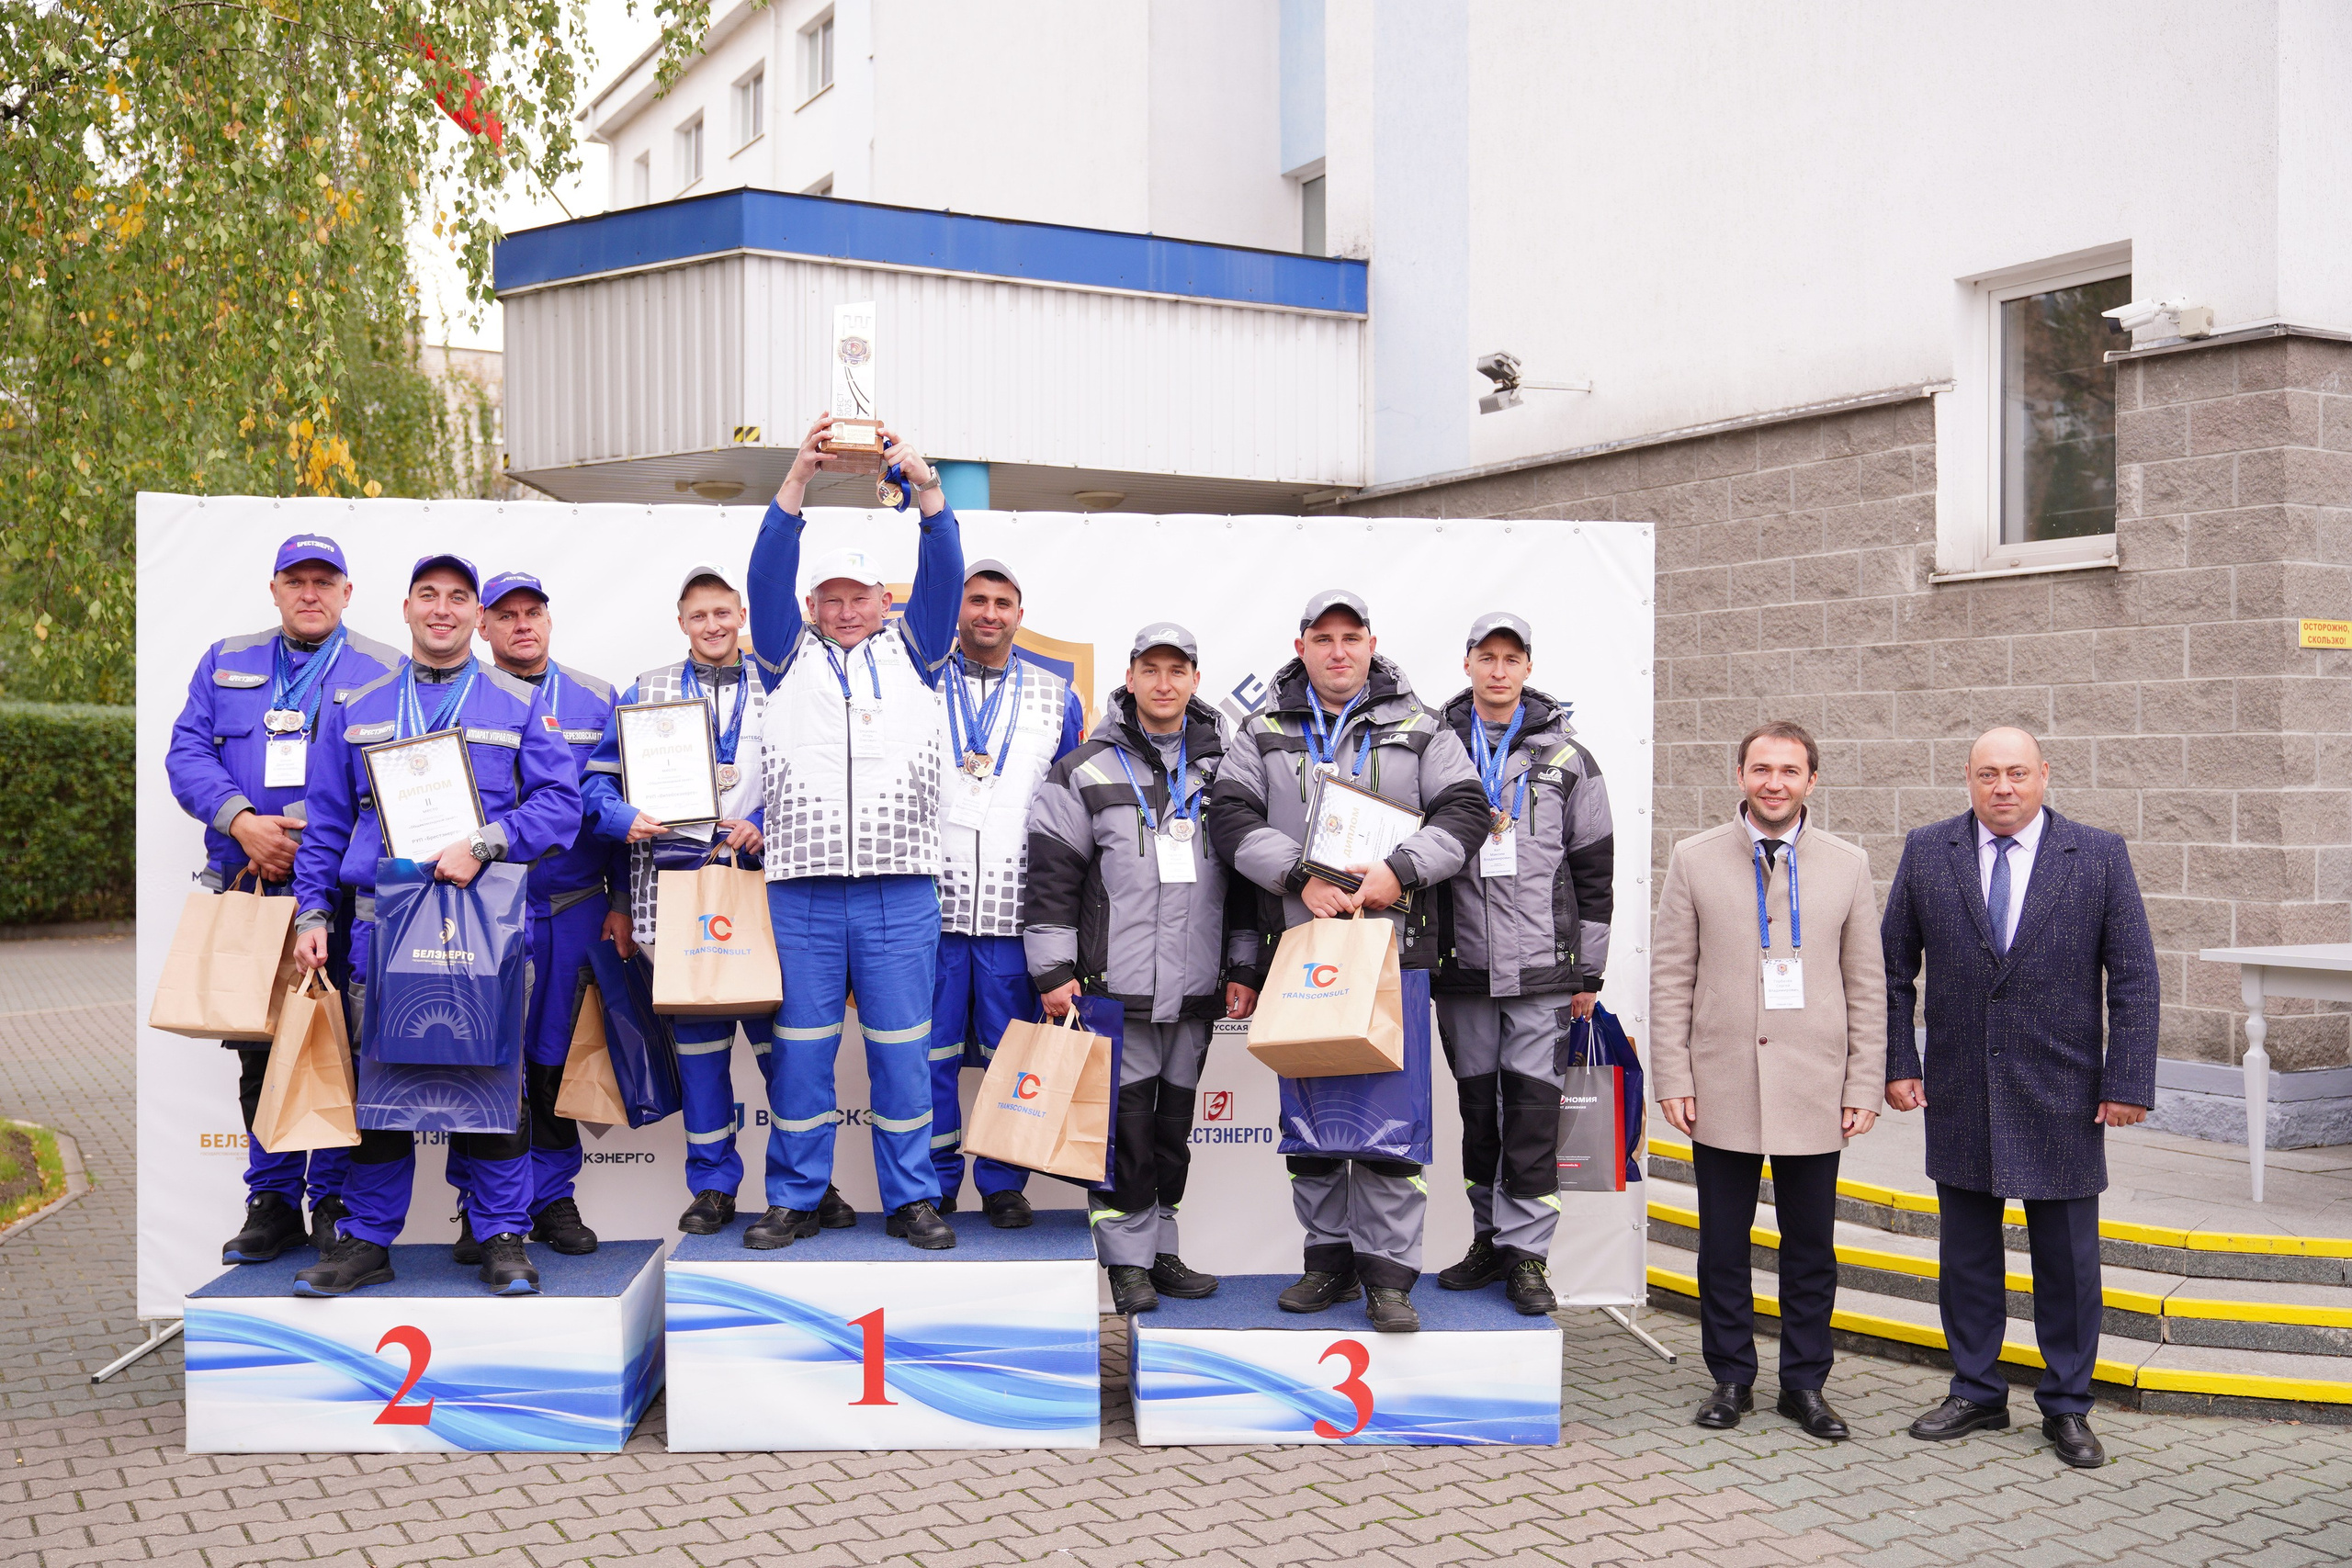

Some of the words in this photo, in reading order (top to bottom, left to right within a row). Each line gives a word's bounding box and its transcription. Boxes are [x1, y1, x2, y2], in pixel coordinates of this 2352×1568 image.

[836, 392, 844, 416] БРЕСТ
[834, 423, 845, 440] 1
[2303, 623, 2349, 634] ОСТОРОЖНО,
[2308, 636, 2346, 645] СКОЛЬЗКО!
[467, 728, 490, 739] АППАРАТ
[490, 729, 521, 745] УПРАВЛЕНИЯ
[562, 731, 597, 740] БЕРЕЗОВСКАЯ
[641, 744, 693, 759] ДИПЛОМ
[398, 779, 452, 801] ДИПЛОМ
[1343, 807, 1361, 859] ДИПЛОМ
[413, 949, 475, 962] БЕЛЭНЕРГО
[684, 946, 752, 957] TRANSCONSULT
[1282, 987, 1351, 999] TRANSCONSULT
[997, 1102, 1046, 1118] TRANSCONSULT
[582, 1153, 655, 1164] КЭНЕРГО
[845, 1307, 899, 1405] 1
[373, 1325, 435, 1427] 2
[1314, 1338, 1374, 1439] 3
